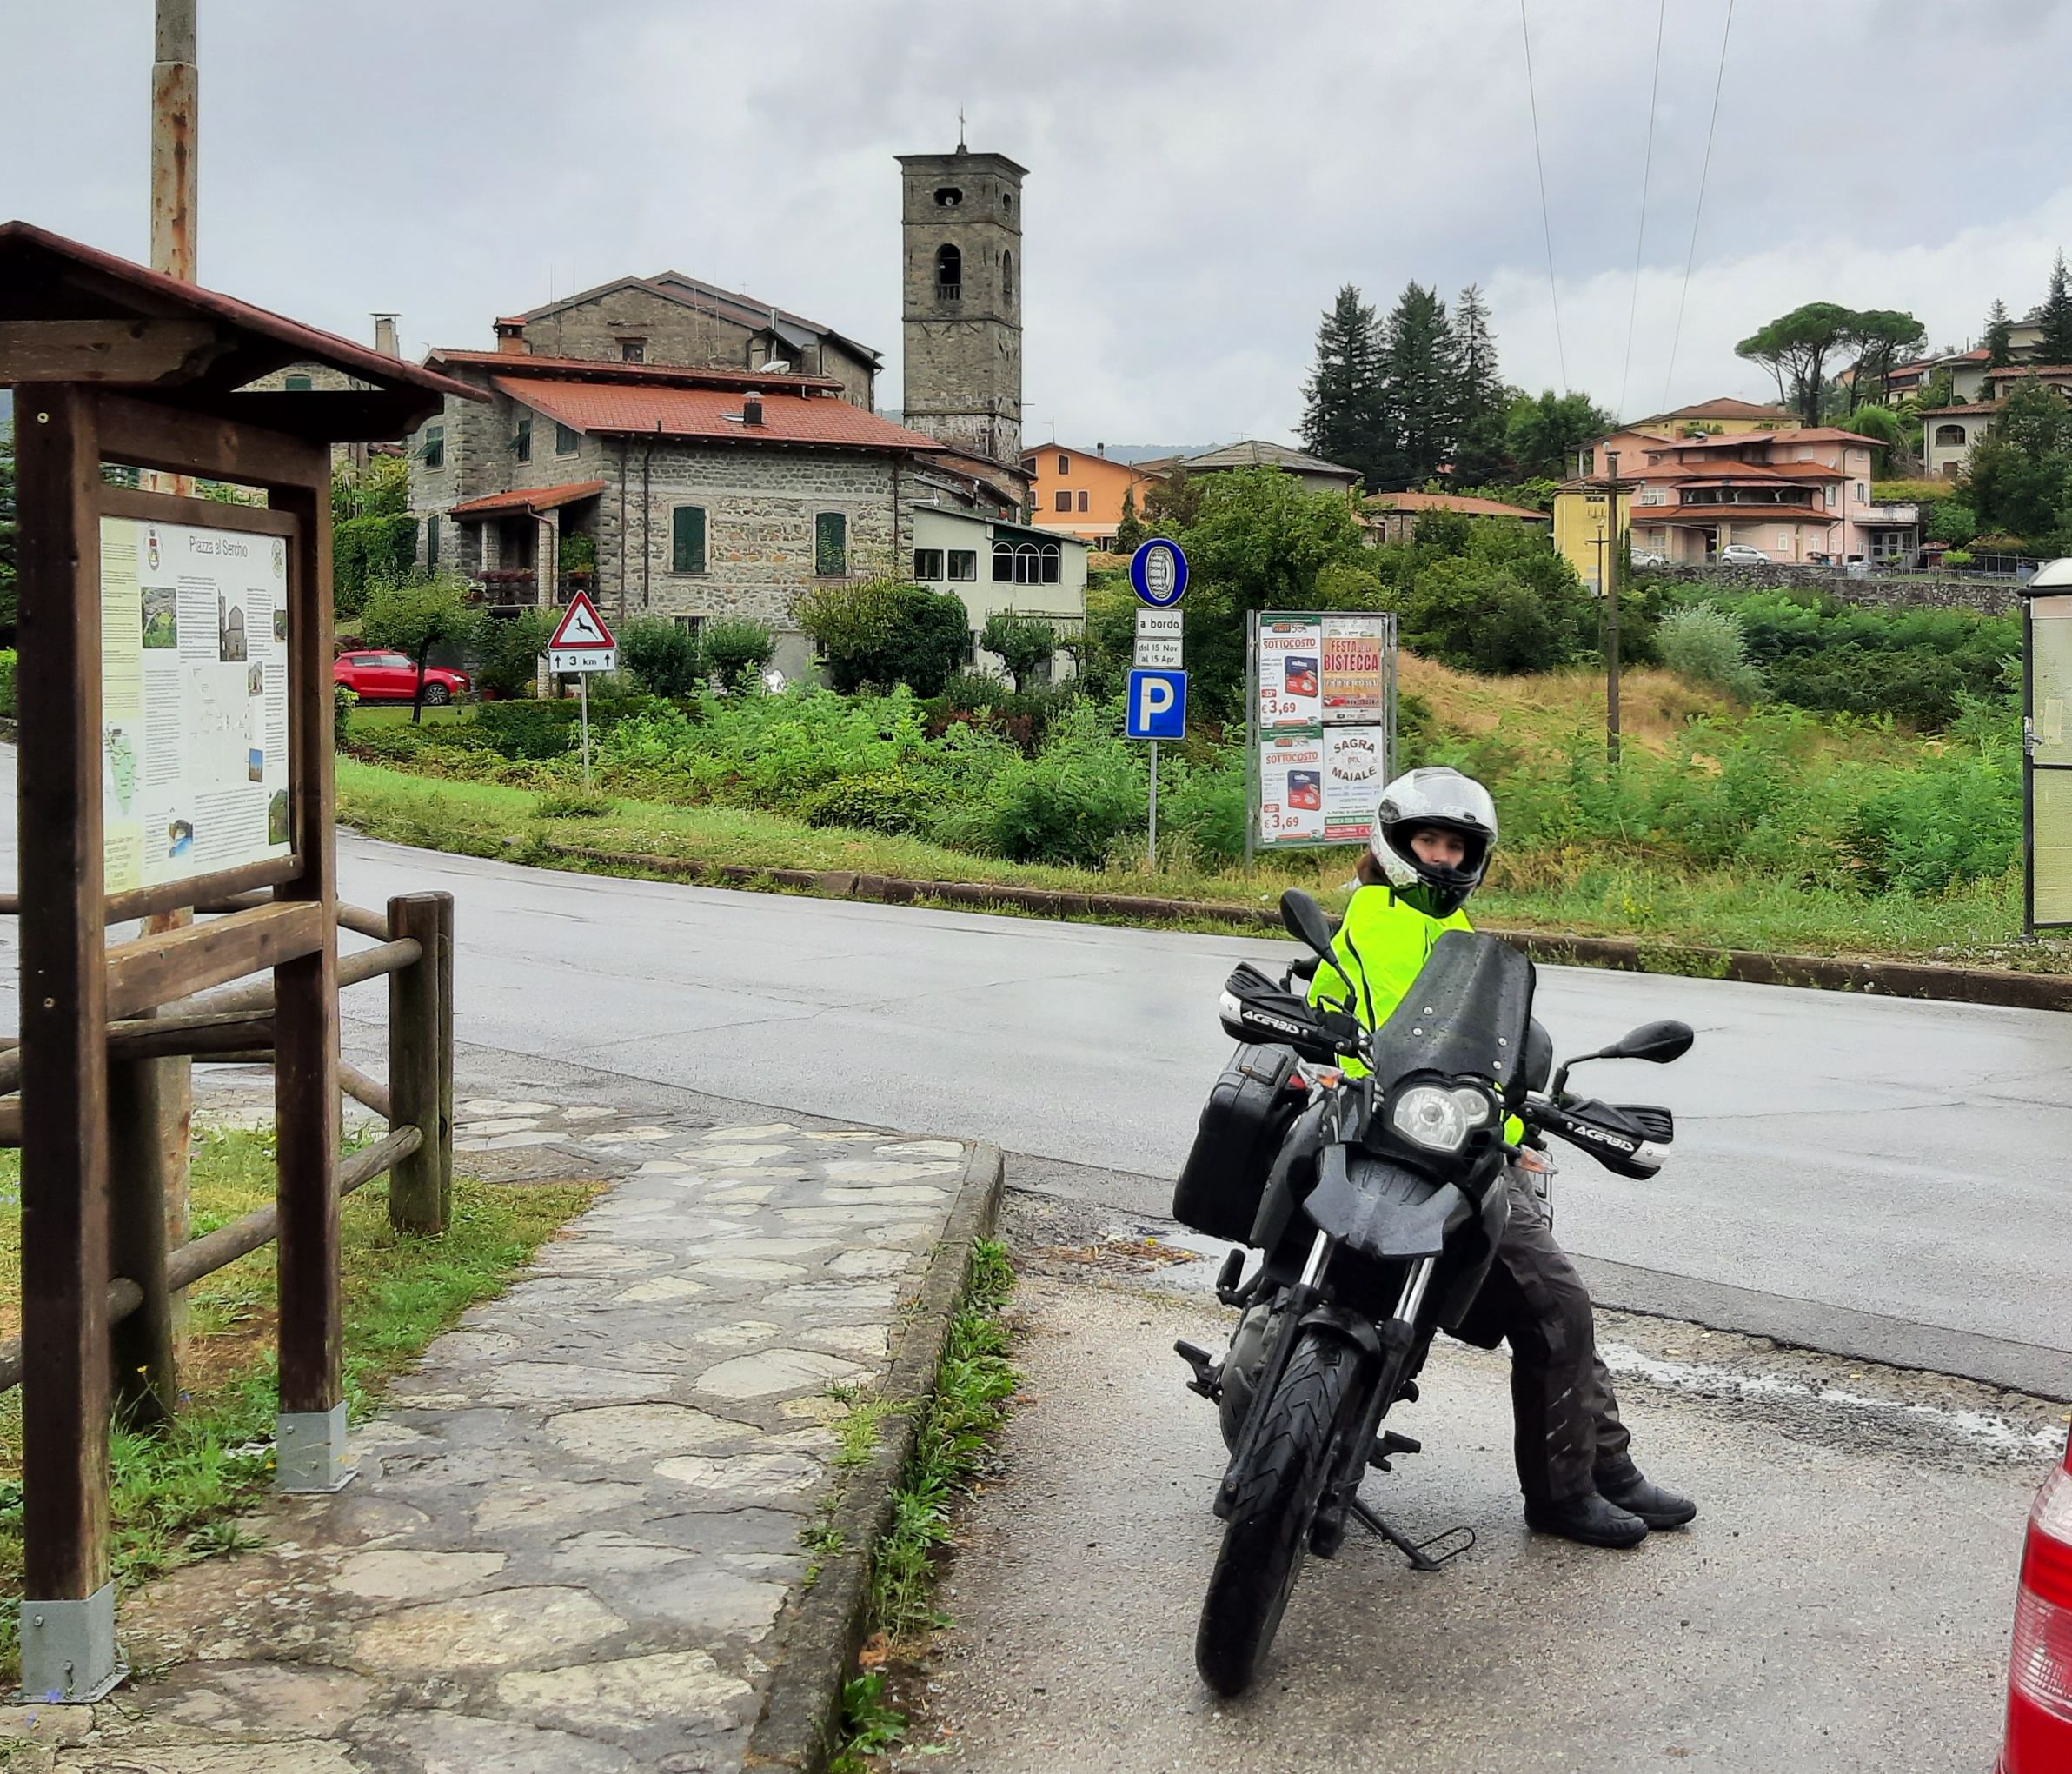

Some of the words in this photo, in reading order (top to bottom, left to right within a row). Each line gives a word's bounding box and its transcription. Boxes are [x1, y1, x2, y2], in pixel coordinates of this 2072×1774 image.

[189, 535, 213, 554] Piazza
[215, 539, 221, 555] al
[222, 539, 248, 557] Serchio
[1151, 618, 1179, 628] bordo
[1263, 639, 1316, 649] SOTTOCOSTO
[1331, 640, 1357, 652] FESTA
[569, 656, 577, 666] 3
[1324, 654, 1378, 671] BISTECCA
[1139, 677, 1174, 731] P
[1333, 738, 1375, 754] SAGRA
[1265, 752, 1318, 764] SOTTOCOSTO
[1332, 766, 1377, 781] MAIALE
[1242, 1010, 1299, 1033] ACERBIS
[1574, 1126, 1634, 1152] ACERBIS
